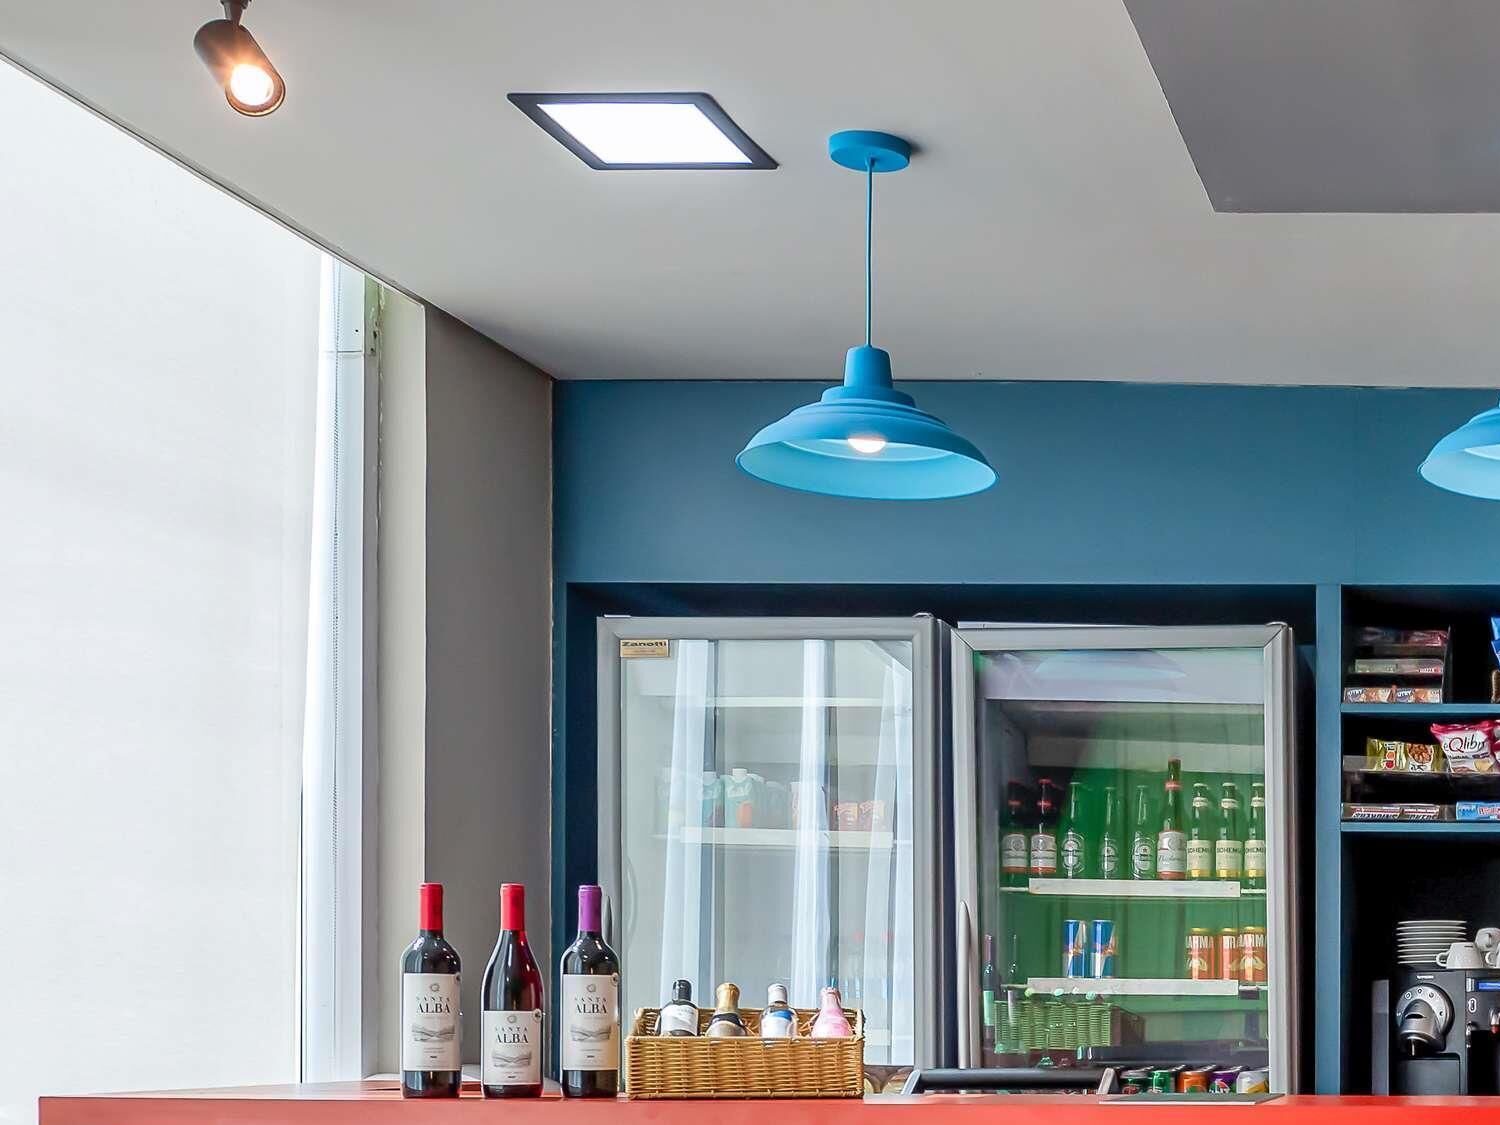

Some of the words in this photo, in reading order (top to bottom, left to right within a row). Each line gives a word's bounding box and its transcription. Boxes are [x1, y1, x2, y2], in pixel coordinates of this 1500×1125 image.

[416, 1003, 450, 1014] ALBA
[575, 1003, 608, 1014] ALBA
[495, 1033, 529, 1044] ALBA
